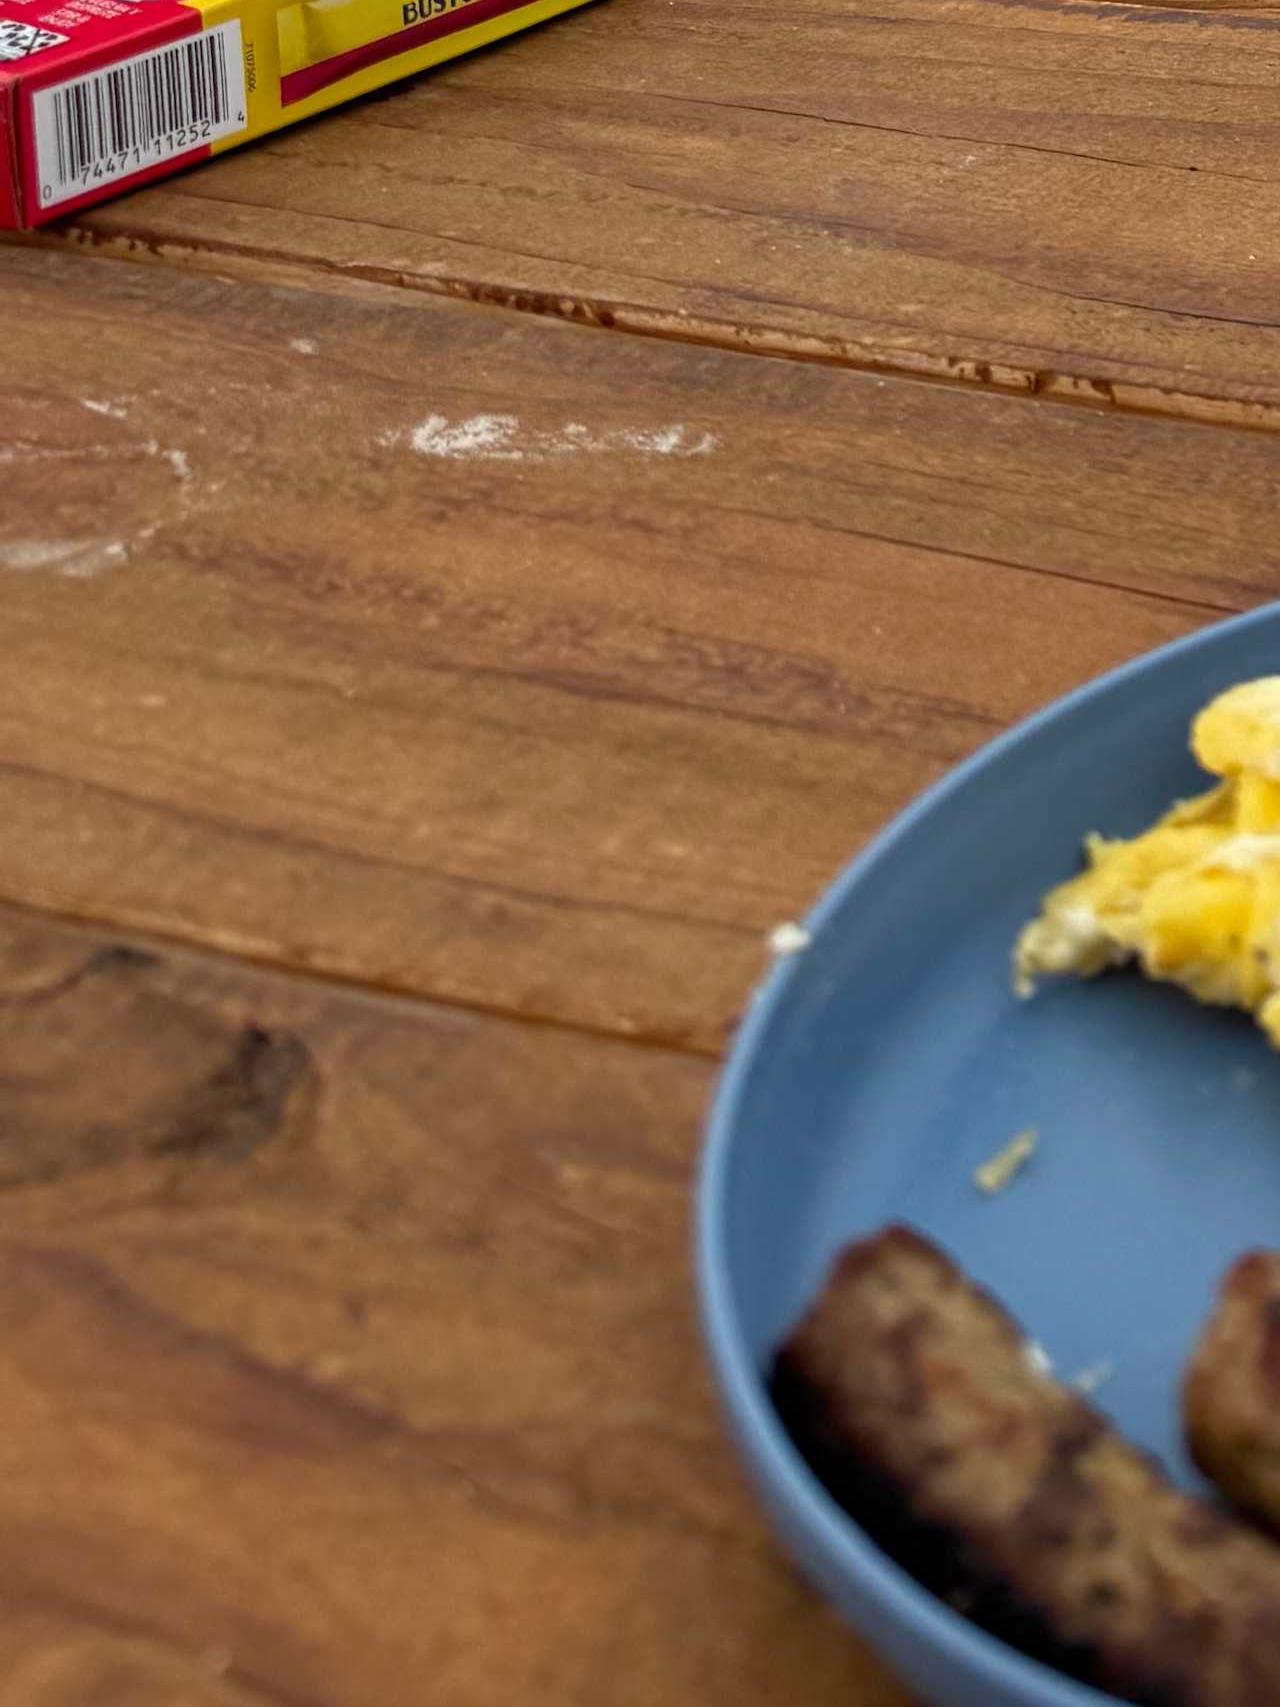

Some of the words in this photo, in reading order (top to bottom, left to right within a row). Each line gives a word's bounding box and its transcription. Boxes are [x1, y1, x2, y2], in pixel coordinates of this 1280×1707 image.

[43, 185, 52, 200] 0
[81, 150, 141, 186] 74471
[153, 120, 211, 155] 11252
[237, 111, 245, 122] 4
